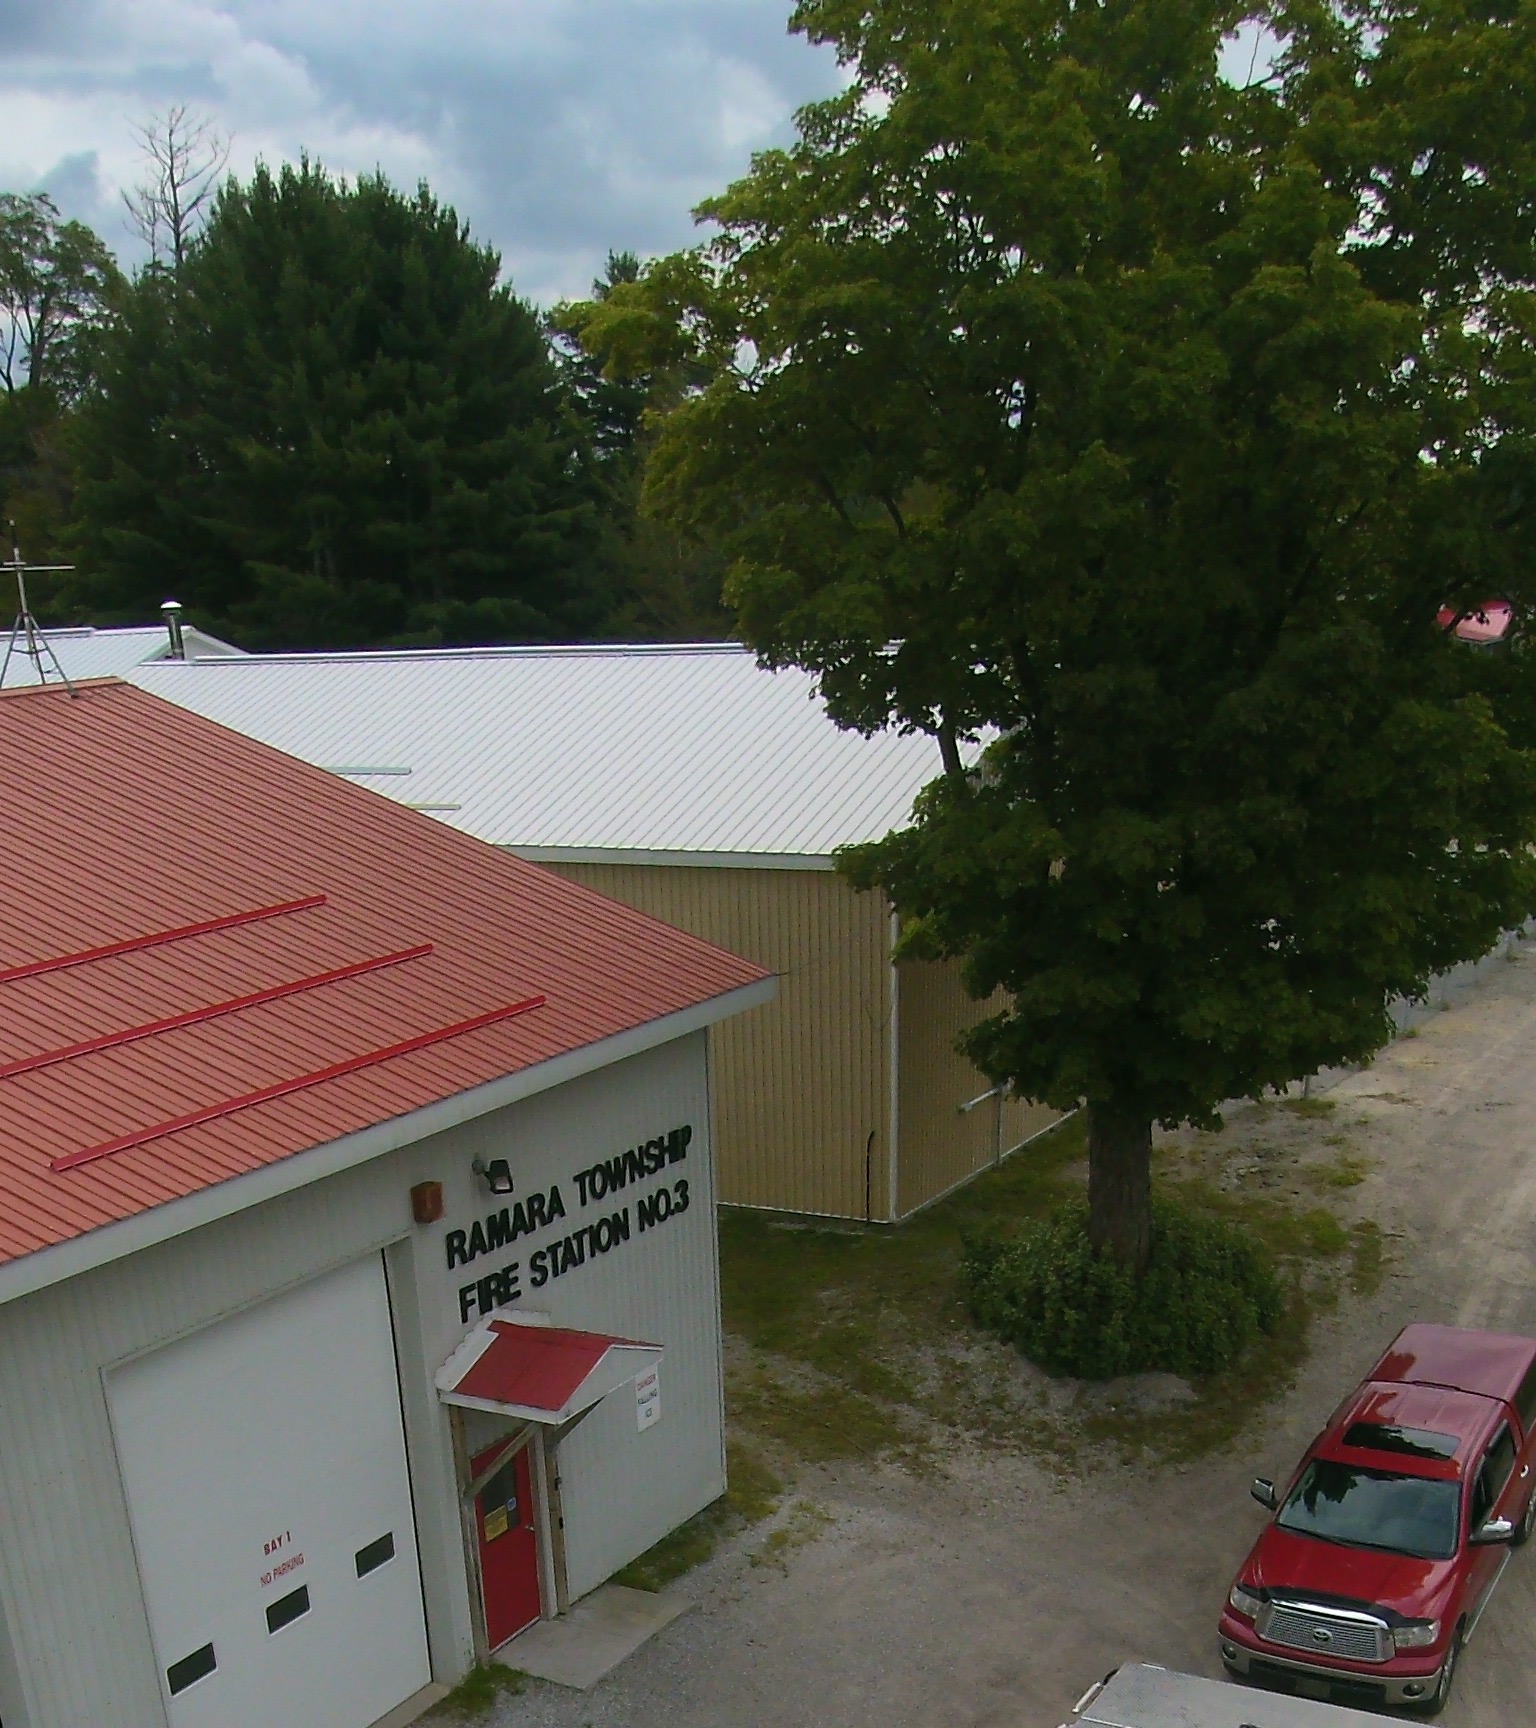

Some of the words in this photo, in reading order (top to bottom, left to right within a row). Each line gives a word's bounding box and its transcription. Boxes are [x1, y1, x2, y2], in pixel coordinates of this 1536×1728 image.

[445, 1185, 566, 1269] RAMARA
[573, 1125, 692, 1207] TOWNSHIP
[458, 1262, 521, 1323] FIRE
[530, 1208, 631, 1288] STATION
[638, 1179, 690, 1232] NO.3
[260, 1572, 272, 1587] NO
[273, 1553, 305, 1580] PARKING
[263, 1535, 282, 1555] BAY
